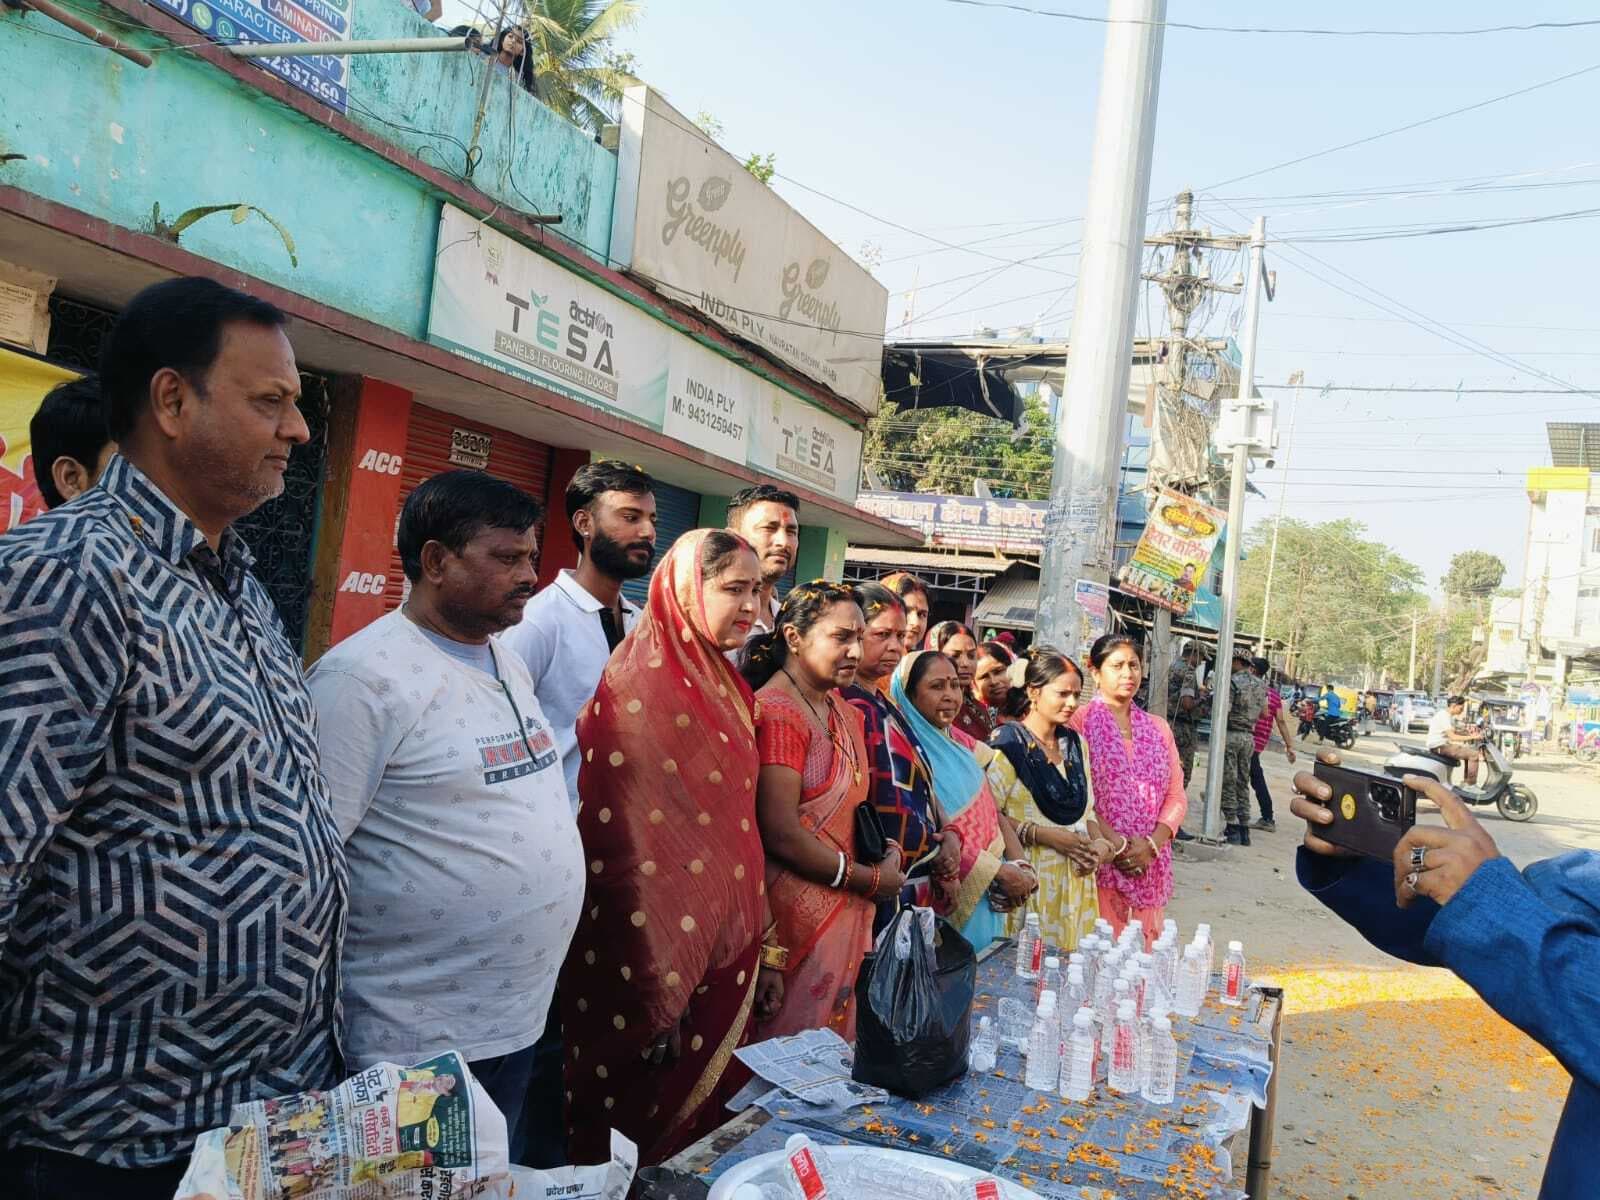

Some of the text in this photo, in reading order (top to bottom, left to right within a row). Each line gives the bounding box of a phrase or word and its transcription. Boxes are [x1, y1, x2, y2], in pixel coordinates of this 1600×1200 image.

[219, 0, 291, 43] ARACTER
[661, 175, 746, 284] Greenply
[700, 291, 739, 327] INDIA
[741, 314, 765, 338] PLY
[779, 262, 841, 348] Greenply
[505, 292, 615, 377] TESA
[500, 335, 536, 362] PANELS
[541, 352, 585, 383] FLOORING
[671, 395, 744, 441] M: 9431259457
[685, 377, 736, 415] INDIA PLY
[357, 448, 403, 476] ACC
[781, 427, 835, 475] TESA
[338, 570, 387, 596] ACC
